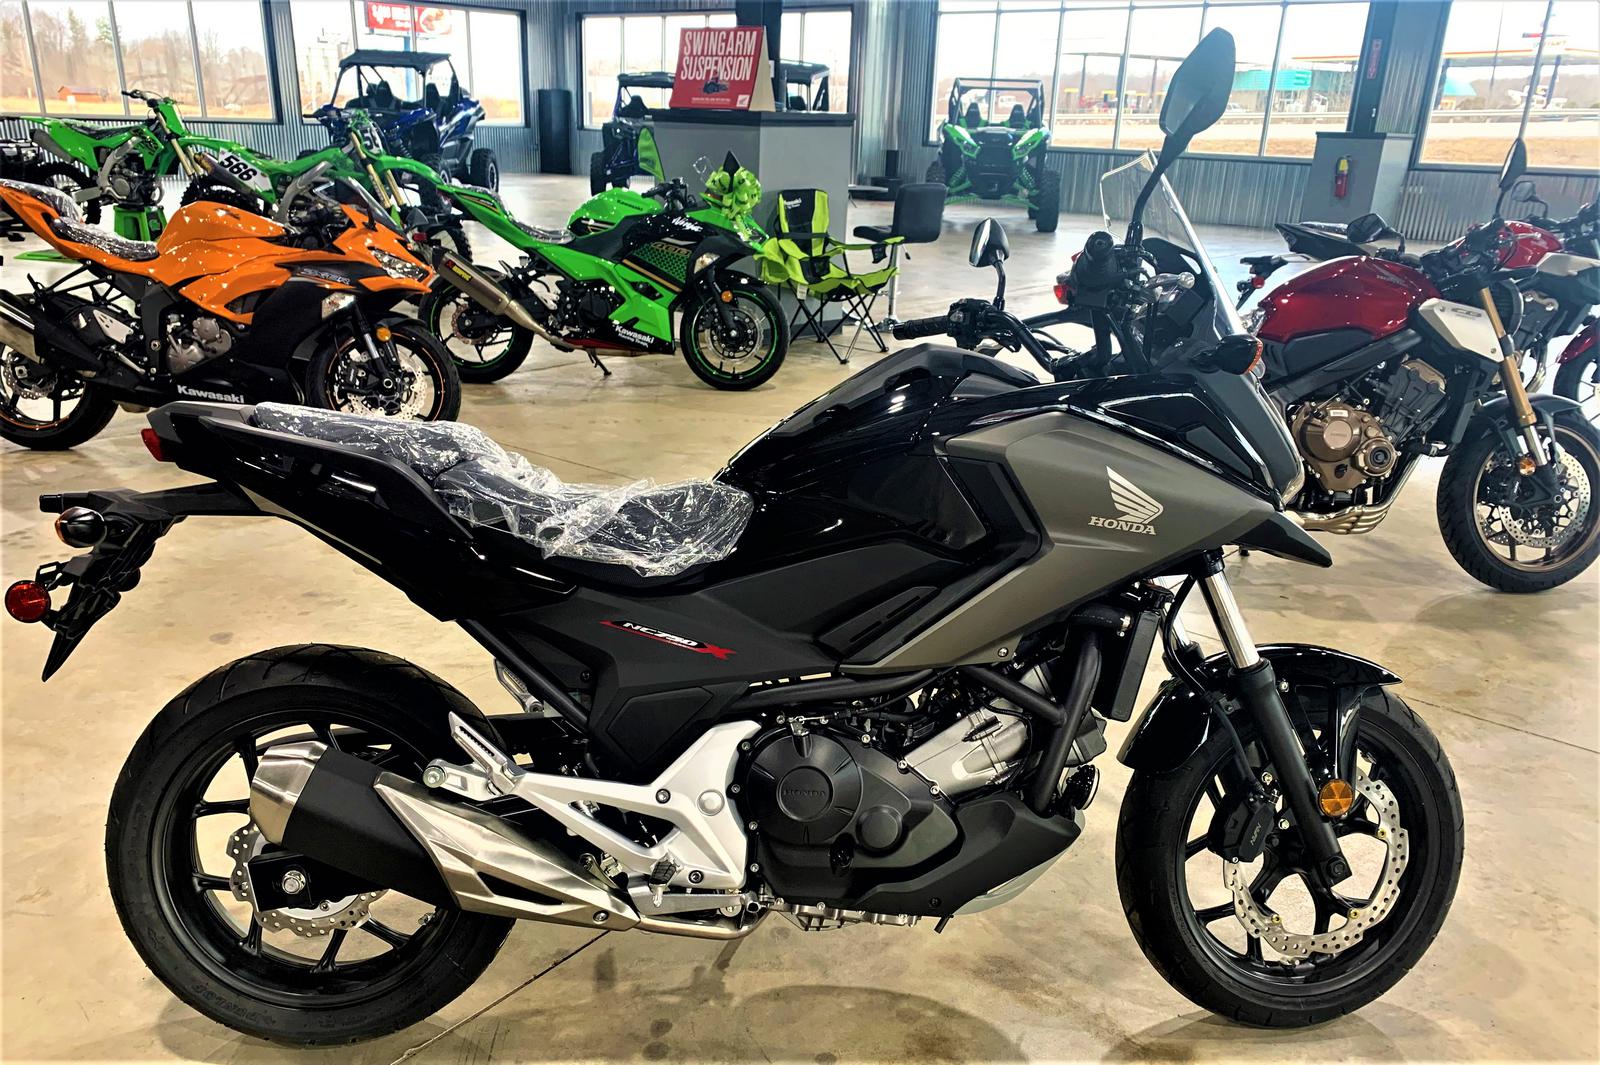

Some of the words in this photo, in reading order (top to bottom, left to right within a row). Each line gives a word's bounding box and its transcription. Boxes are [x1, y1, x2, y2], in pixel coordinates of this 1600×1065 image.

[683, 31, 757, 56] SWINGARM
[680, 56, 753, 81] SUSPENSION
[219, 155, 257, 181] 566
[671, 216, 704, 233] Ninja
[615, 325, 655, 344] Kawasaki
[177, 384, 245, 404] Kawasaki
[1086, 516, 1157, 536] HONDA
[783, 789, 826, 798] HONDA
